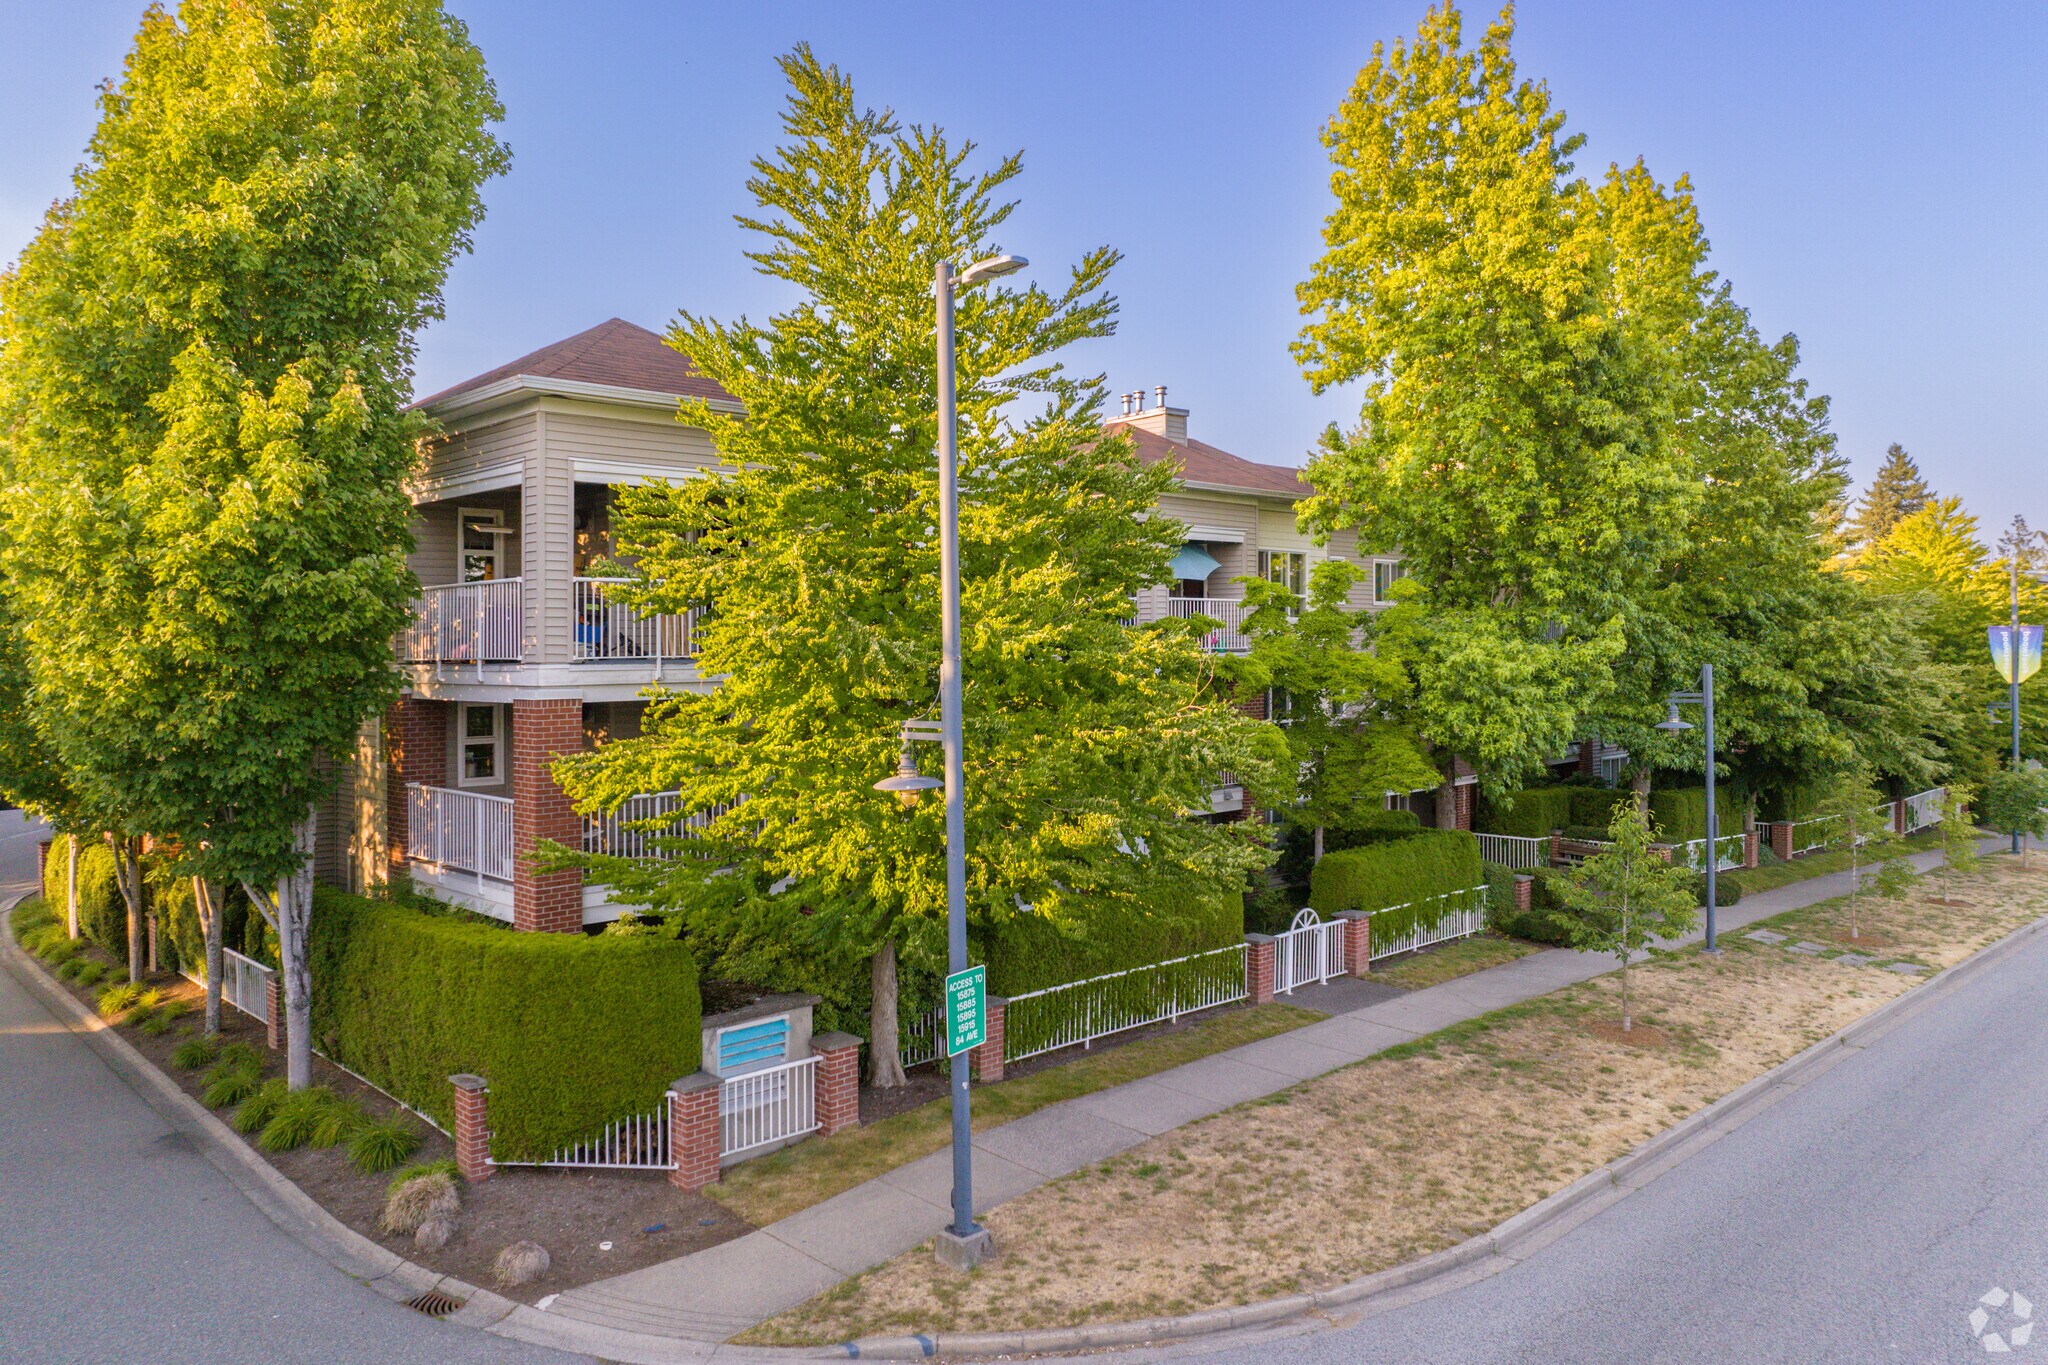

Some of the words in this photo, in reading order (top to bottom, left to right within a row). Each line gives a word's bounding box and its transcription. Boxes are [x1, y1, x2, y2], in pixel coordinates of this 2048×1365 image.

[949, 977, 973, 992] ACCESS
[975, 974, 983, 983] TO
[957, 987, 975, 1000] 15875
[956, 998, 976, 1011] 15885
[957, 1009, 976, 1022] 15895
[958, 1020, 975, 1033] 15915
[956, 1036, 964, 1046] 84
[966, 1029, 978, 1042] AVE
